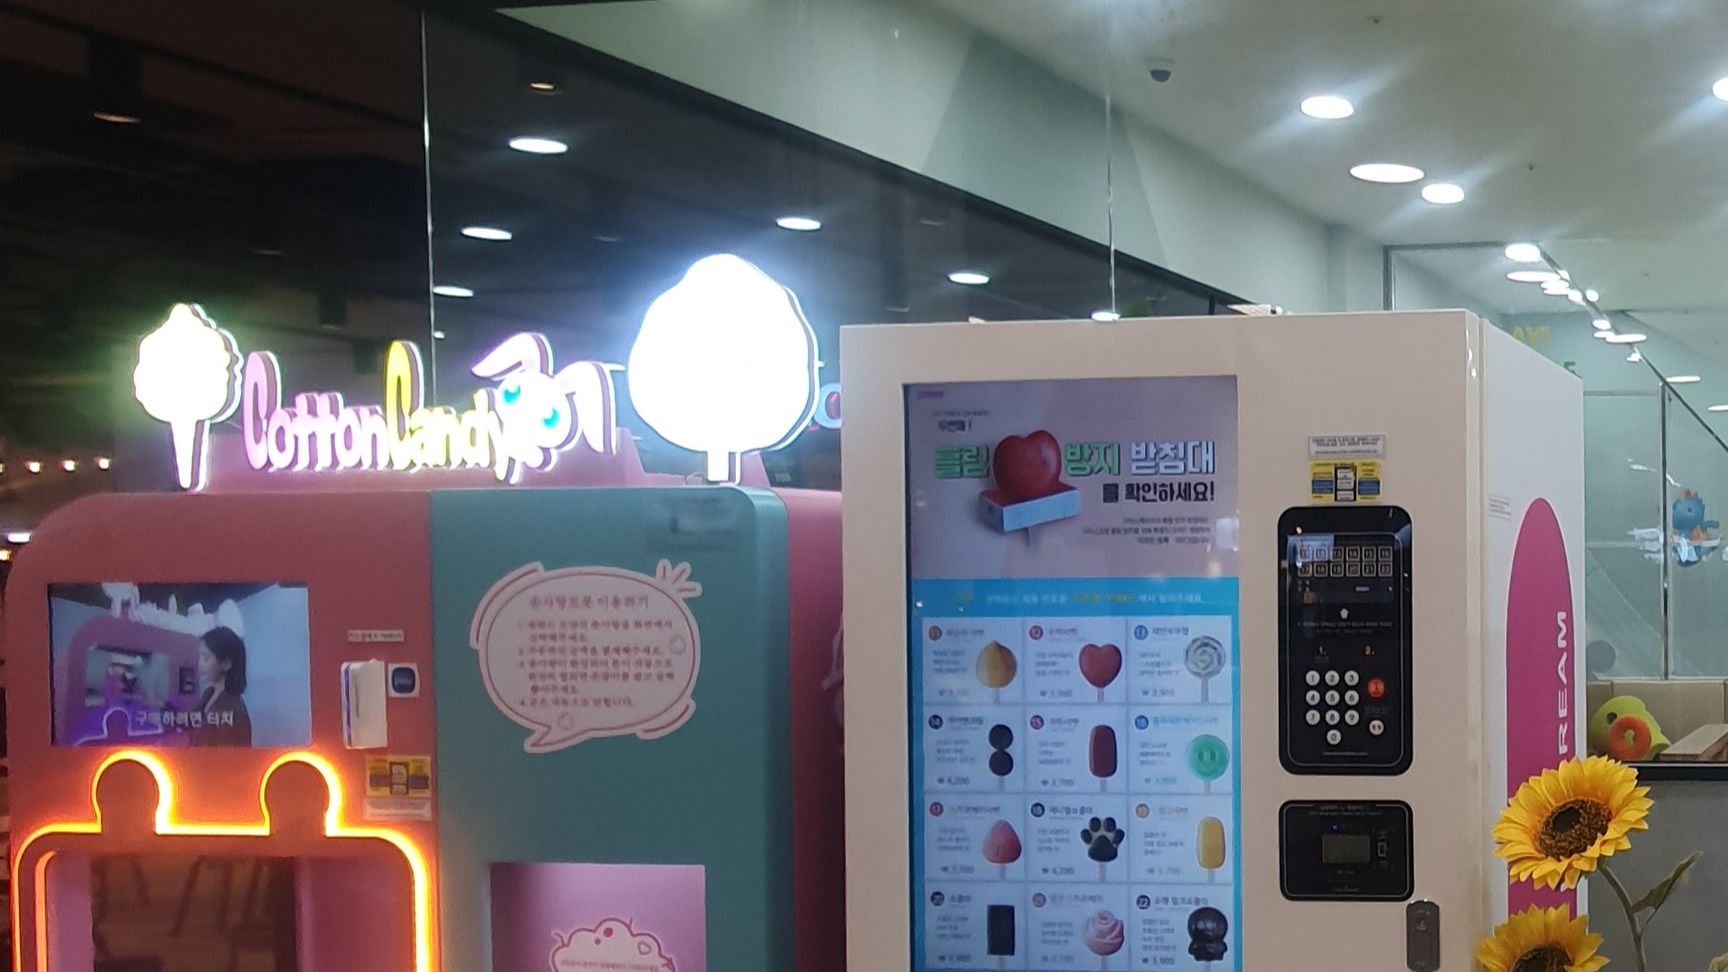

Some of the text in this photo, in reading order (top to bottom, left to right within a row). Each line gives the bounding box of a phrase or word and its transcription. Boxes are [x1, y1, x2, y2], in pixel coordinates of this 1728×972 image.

[1064, 441, 1121, 477] 방지
[1130, 440, 1216, 475] 받침대
[1125, 481, 1215, 503] 확인하세요!
[1556, 611, 1569, 764] REAM
